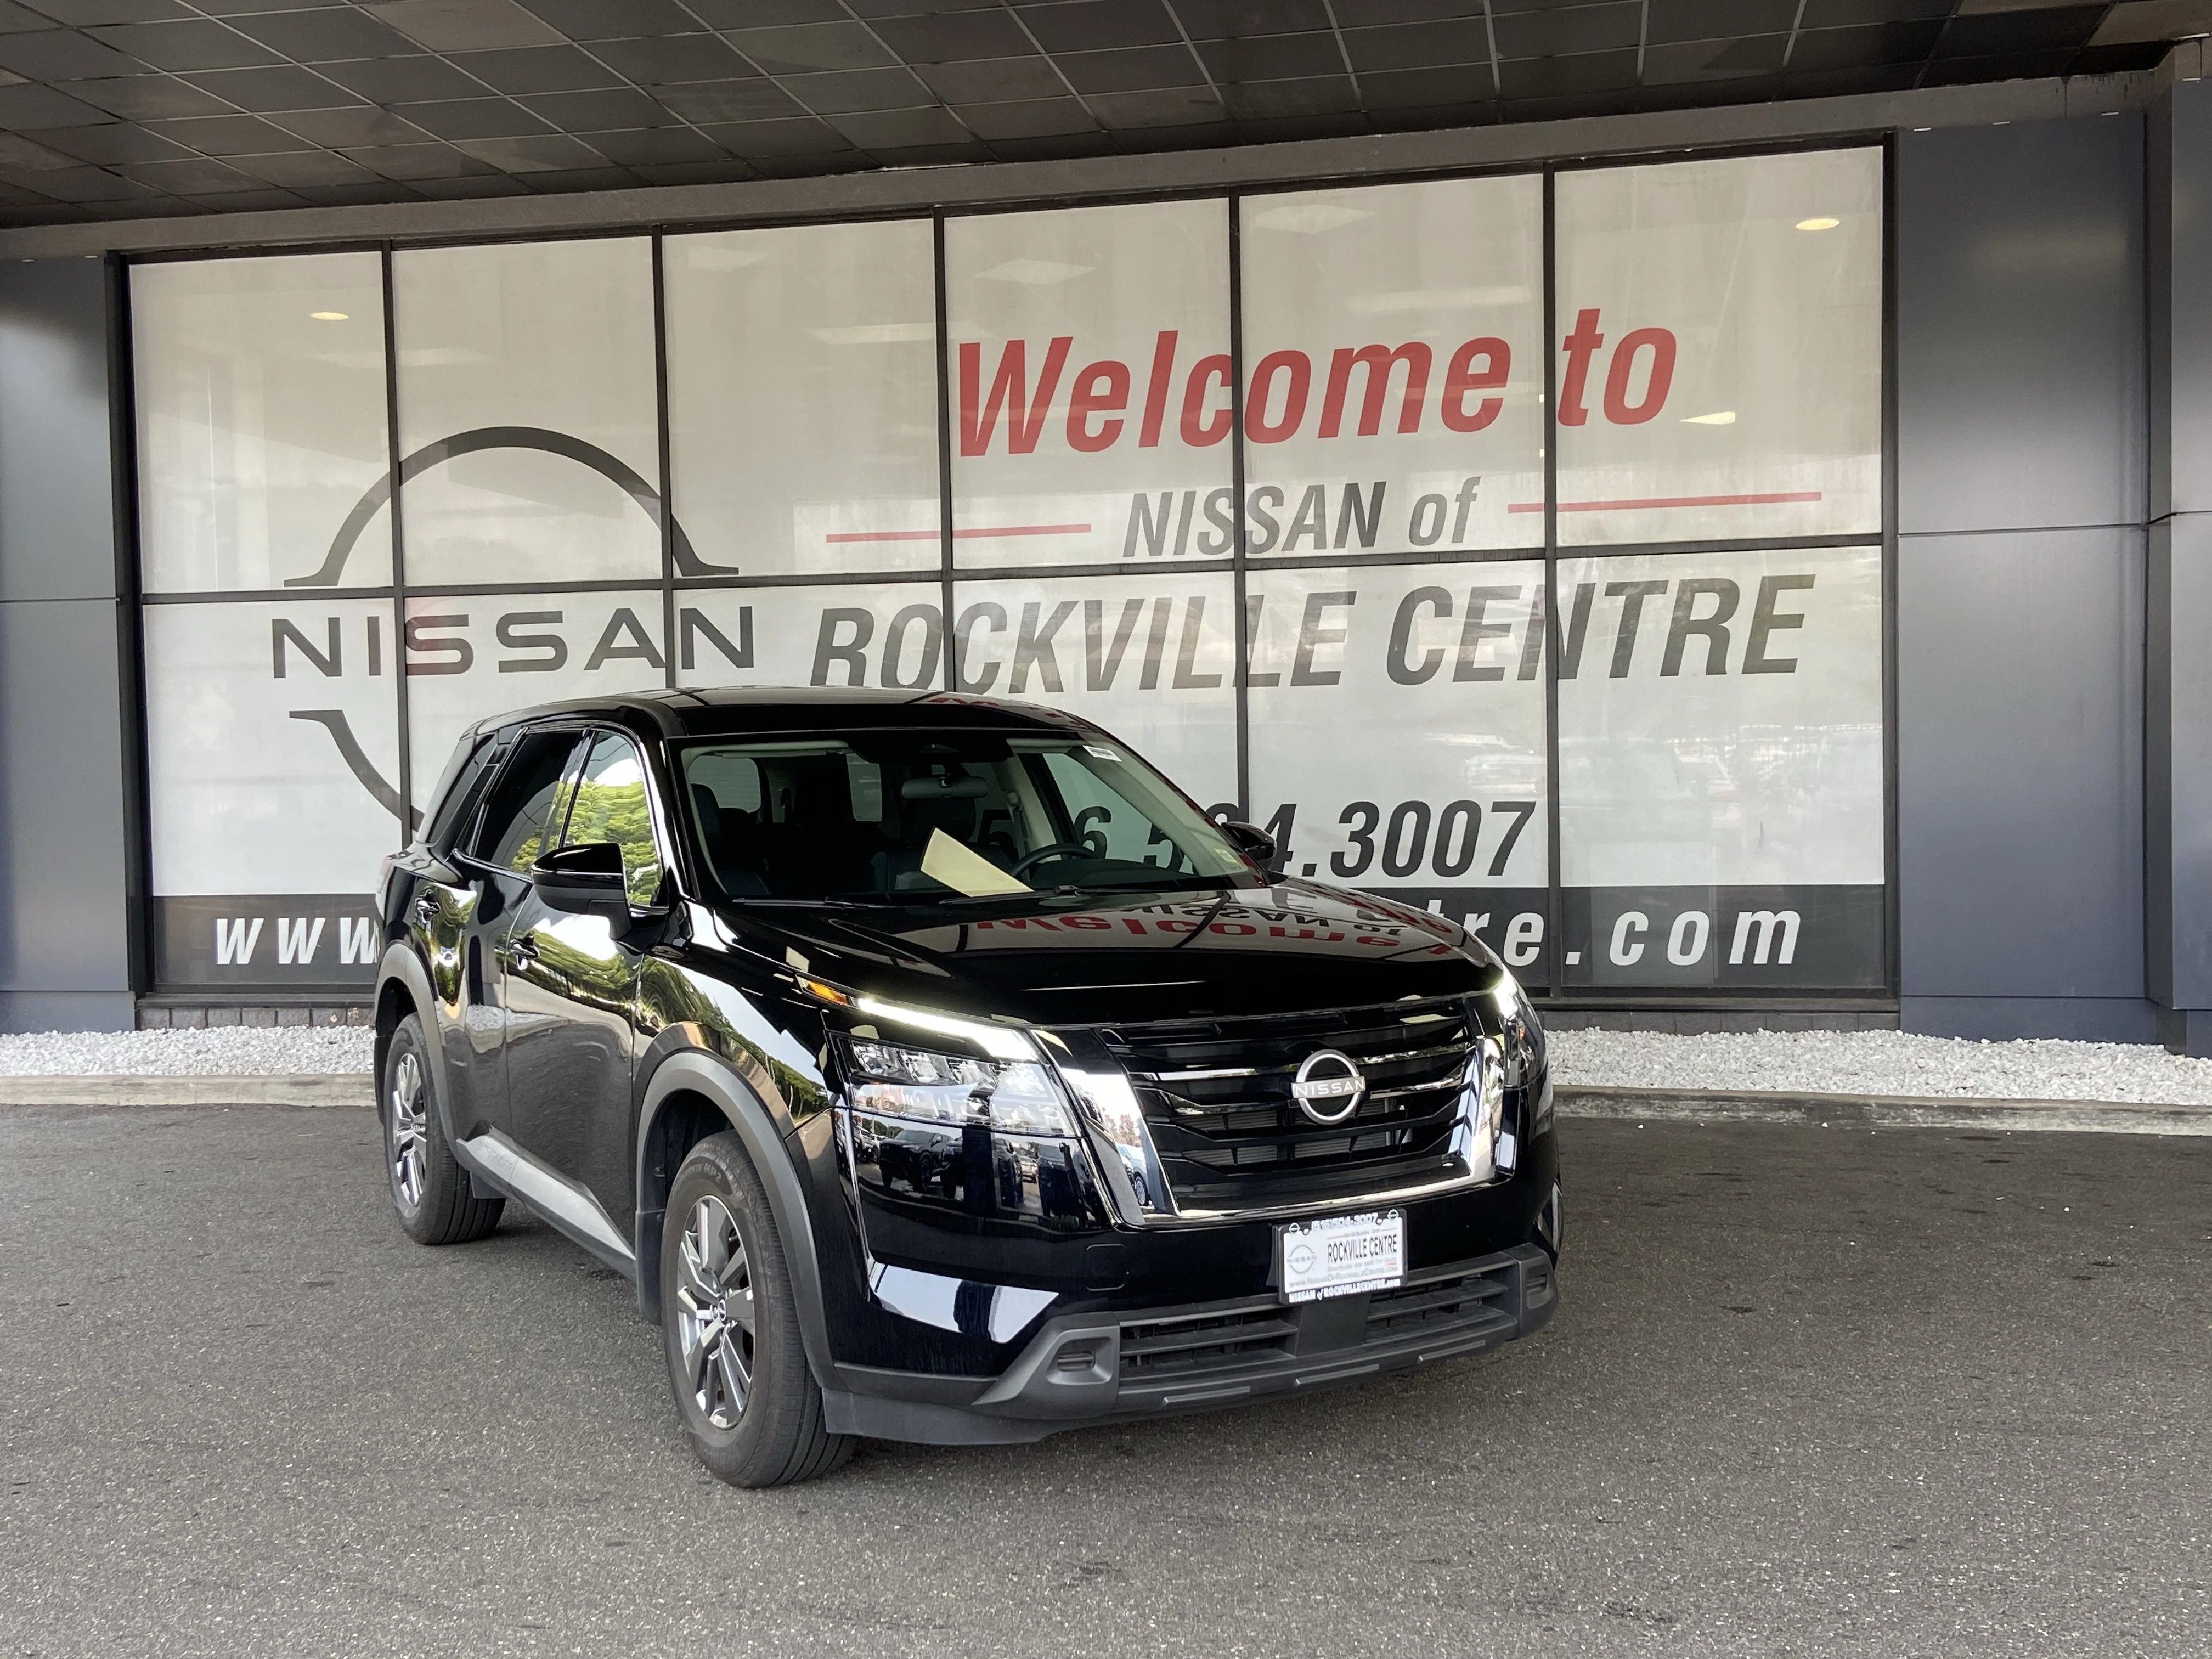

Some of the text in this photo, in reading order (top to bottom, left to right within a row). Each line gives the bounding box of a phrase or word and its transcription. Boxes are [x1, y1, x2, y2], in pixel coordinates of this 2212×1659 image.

[958, 308, 1678, 458] Welcome to
[1123, 476, 1482, 558] NISSAN of
[272, 606, 754, 679] NISSAN
[809, 574, 1816, 695] ROCKVILLE CENTRE
[1295, 1079, 1364, 1096] NISSAN
[1328, 1232, 1397, 1264] ROCKVILLE CENTRE
[1344, 1230, 1370, 1238] NISSAN
[1287, 1255, 1317, 1263] NISSAN
[1289, 1289, 1316, 1304] NISSAN
